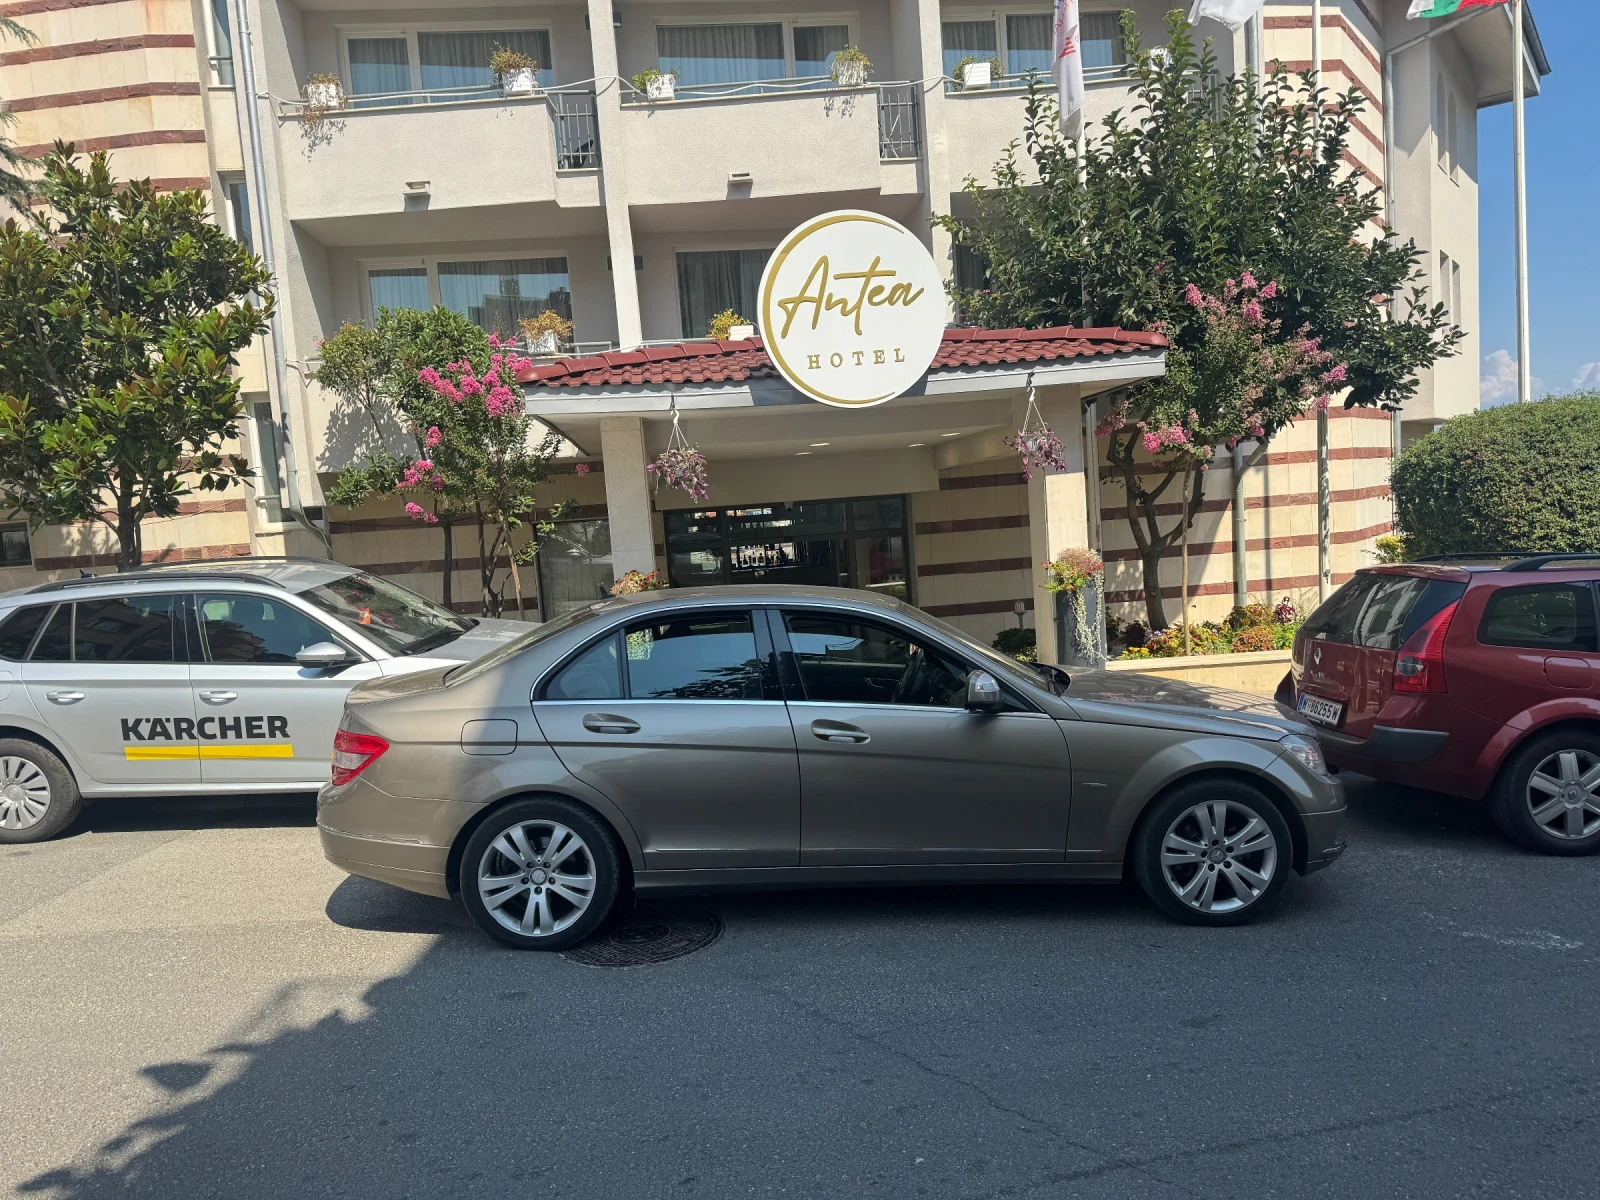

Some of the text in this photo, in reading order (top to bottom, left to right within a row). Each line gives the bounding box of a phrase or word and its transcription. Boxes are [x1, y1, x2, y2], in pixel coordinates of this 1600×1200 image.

[778, 255, 924, 339] Antea
[807, 348, 905, 369] HOTEL
[121, 716, 291, 741] KÄRCHER
